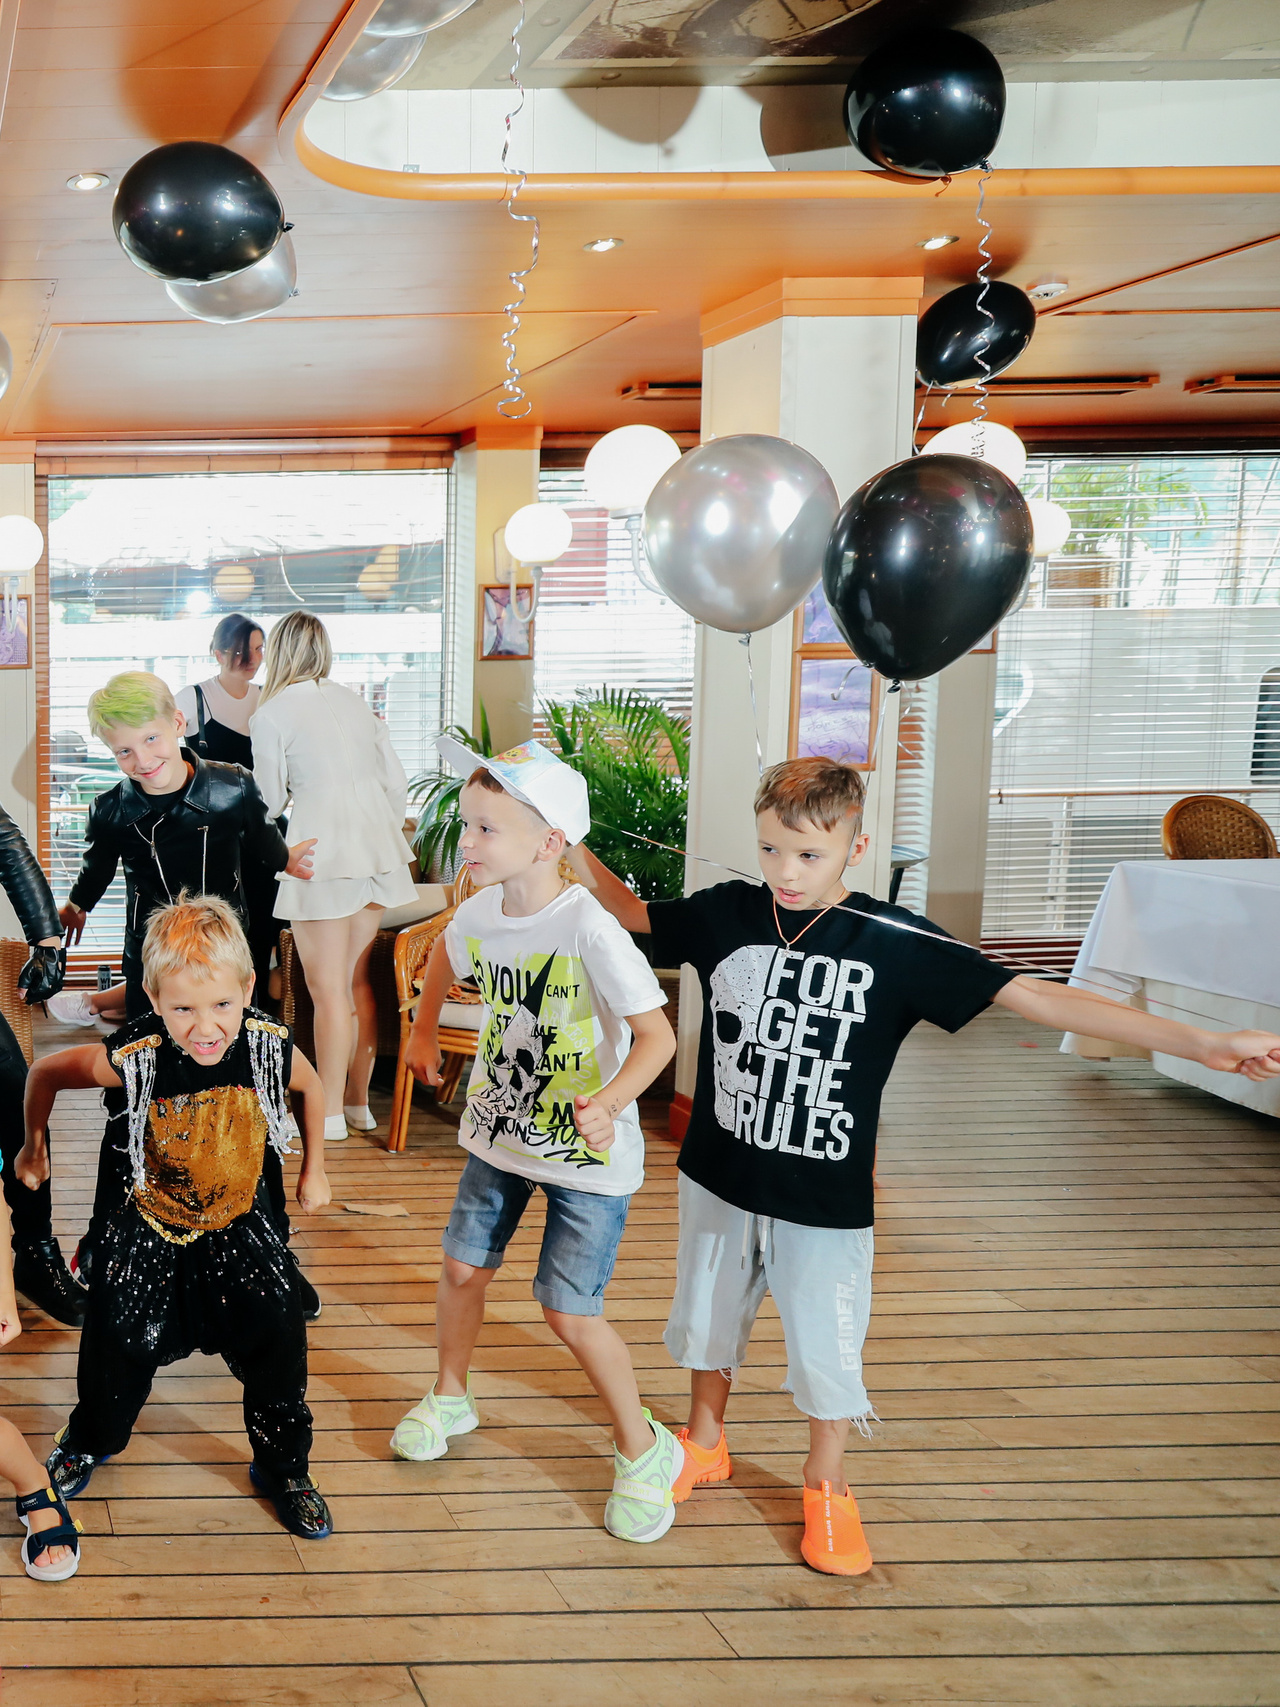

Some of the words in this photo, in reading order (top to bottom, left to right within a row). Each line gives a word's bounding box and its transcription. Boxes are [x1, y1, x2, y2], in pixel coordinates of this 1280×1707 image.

[488, 961, 532, 1006] YOU
[545, 984, 580, 998] CAN'T
[766, 947, 874, 1015] FOR
[535, 1051, 583, 1072] AN'T
[757, 998, 866, 1061] GET
[755, 1045, 852, 1111] THE
[734, 1089, 855, 1162] RULES
